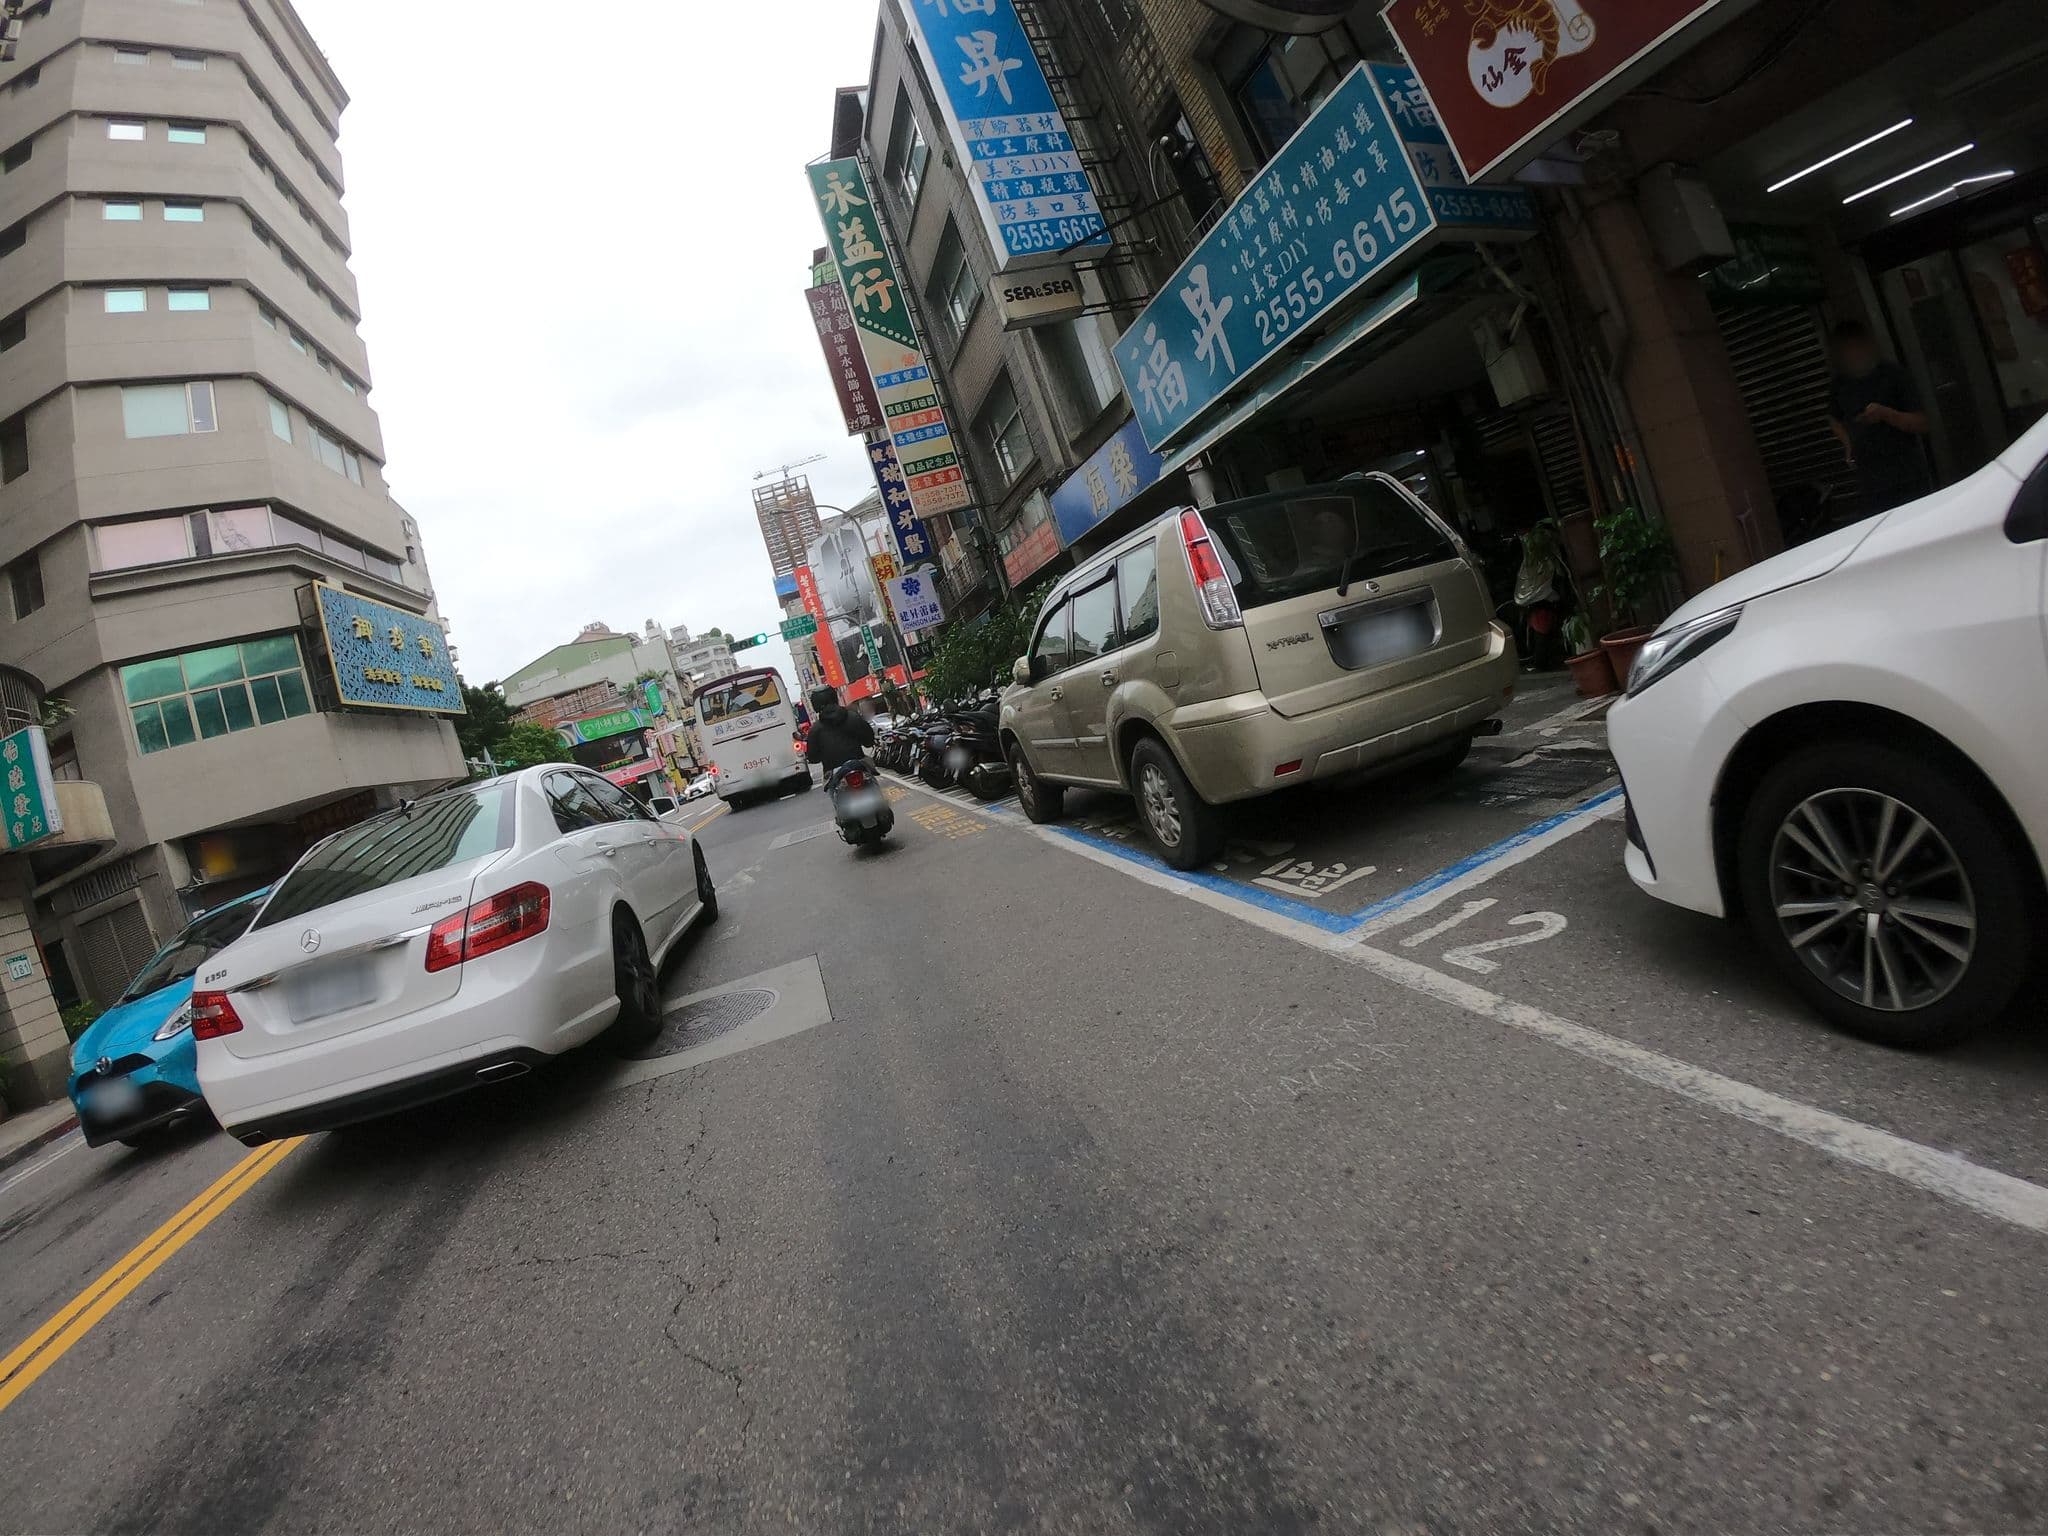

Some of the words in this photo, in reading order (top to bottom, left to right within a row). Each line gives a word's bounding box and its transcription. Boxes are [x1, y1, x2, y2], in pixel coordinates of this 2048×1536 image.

[923, 0, 1023, 105] 昇
[976, 133, 1065, 157] 化工原料
[1000, 194, 1091, 221] 防毒口罩
[821, 171, 894, 314] 永益行
[1006, 215, 1102, 251] 2555-6615
[1254, 186, 1418, 347] 2555-6615
[1003, 280, 1075, 303] SEA&SEA
[1131, 264, 1237, 427] 福昇
[1266, 632, 1314, 651] X-TRAIL
[12, 962, 31, 979] 181
[204, 968, 228, 985] E350
